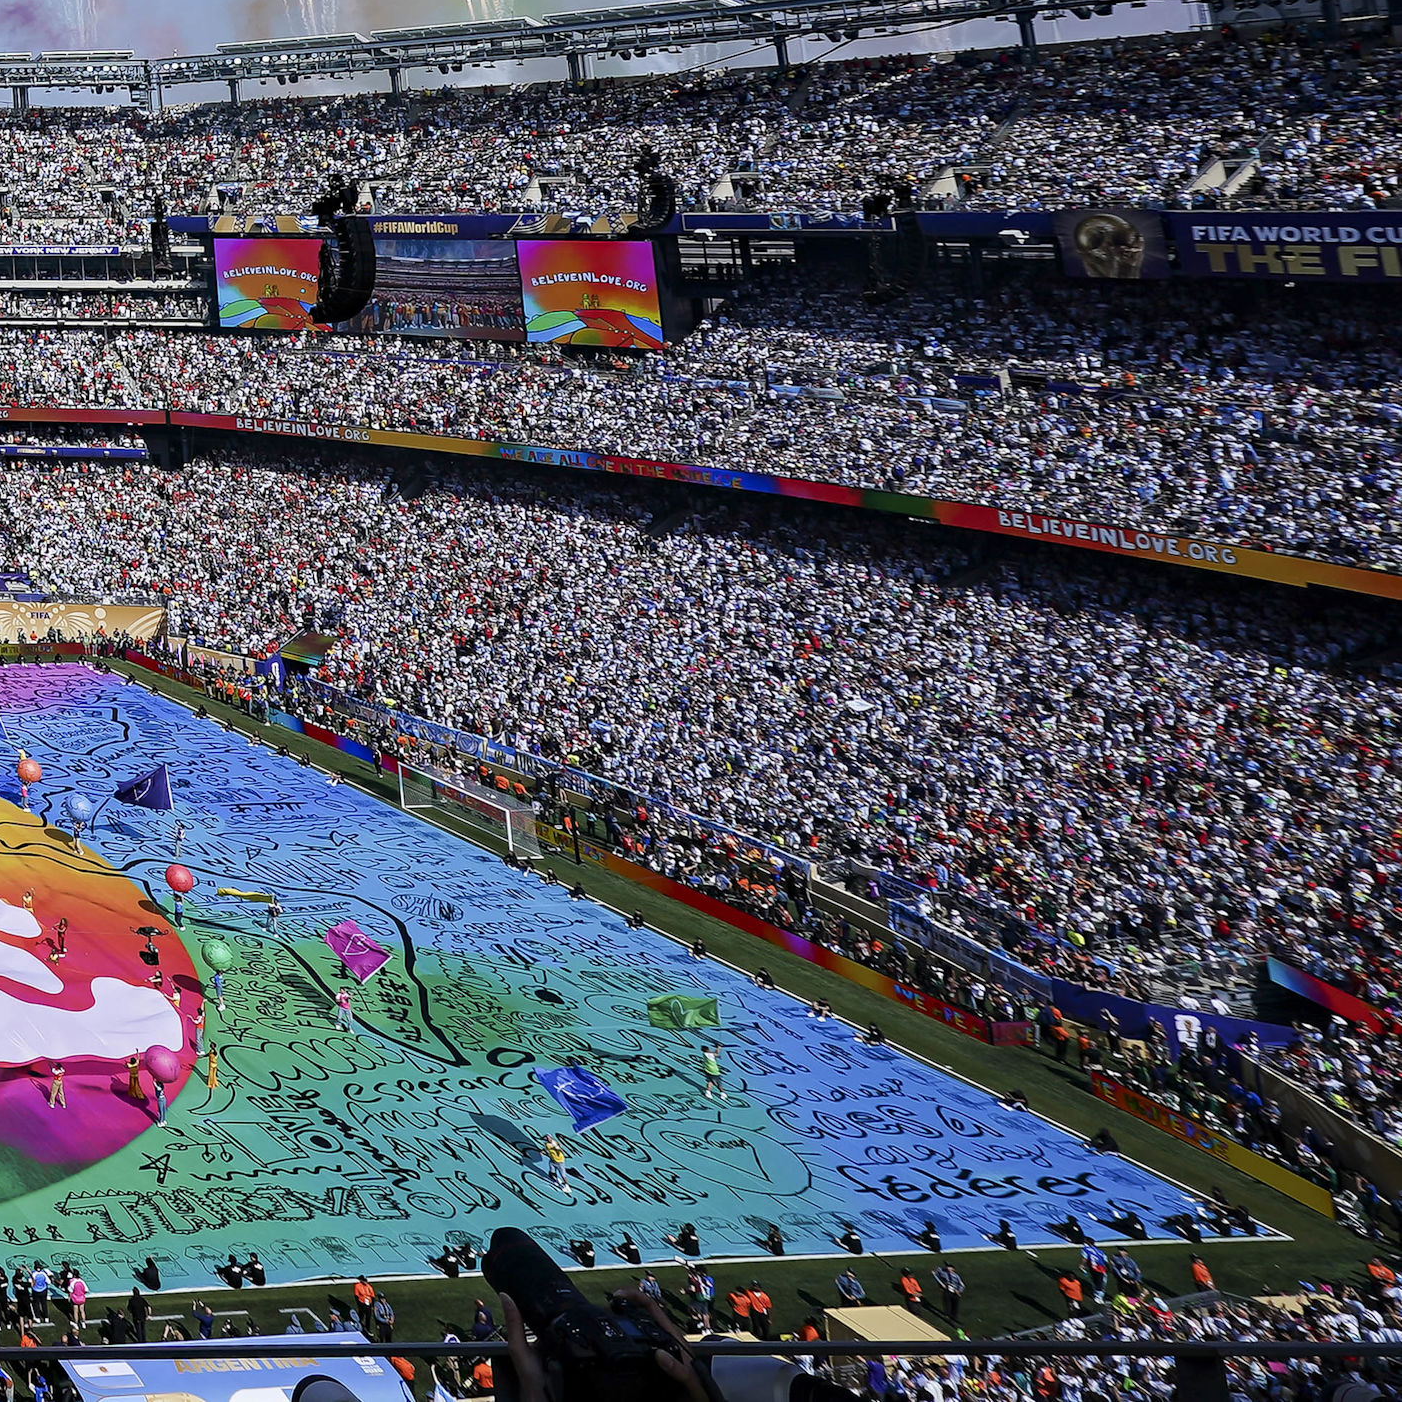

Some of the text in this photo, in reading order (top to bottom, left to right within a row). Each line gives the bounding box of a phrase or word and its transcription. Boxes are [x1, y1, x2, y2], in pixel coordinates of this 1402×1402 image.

[373, 221, 458, 235] #FIFAWorldCup
[1191, 225, 1402, 243] FIFA WORLD CU
[1195, 243, 1326, 275] THE
[223, 264, 318, 284] BELIEVEINLOVE.ORG
[531, 270, 648, 293] BELIEVEINLOVE.ORG
[236, 417, 370, 442] BELIEVEINLOVE.ORG
[499, 447, 524, 460] WE
[636, 463, 666, 478] THE
[997, 509, 1237, 565] BELIEVEINLOVE.ORG
[173, 1356, 321, 1375] ARGENTINA
